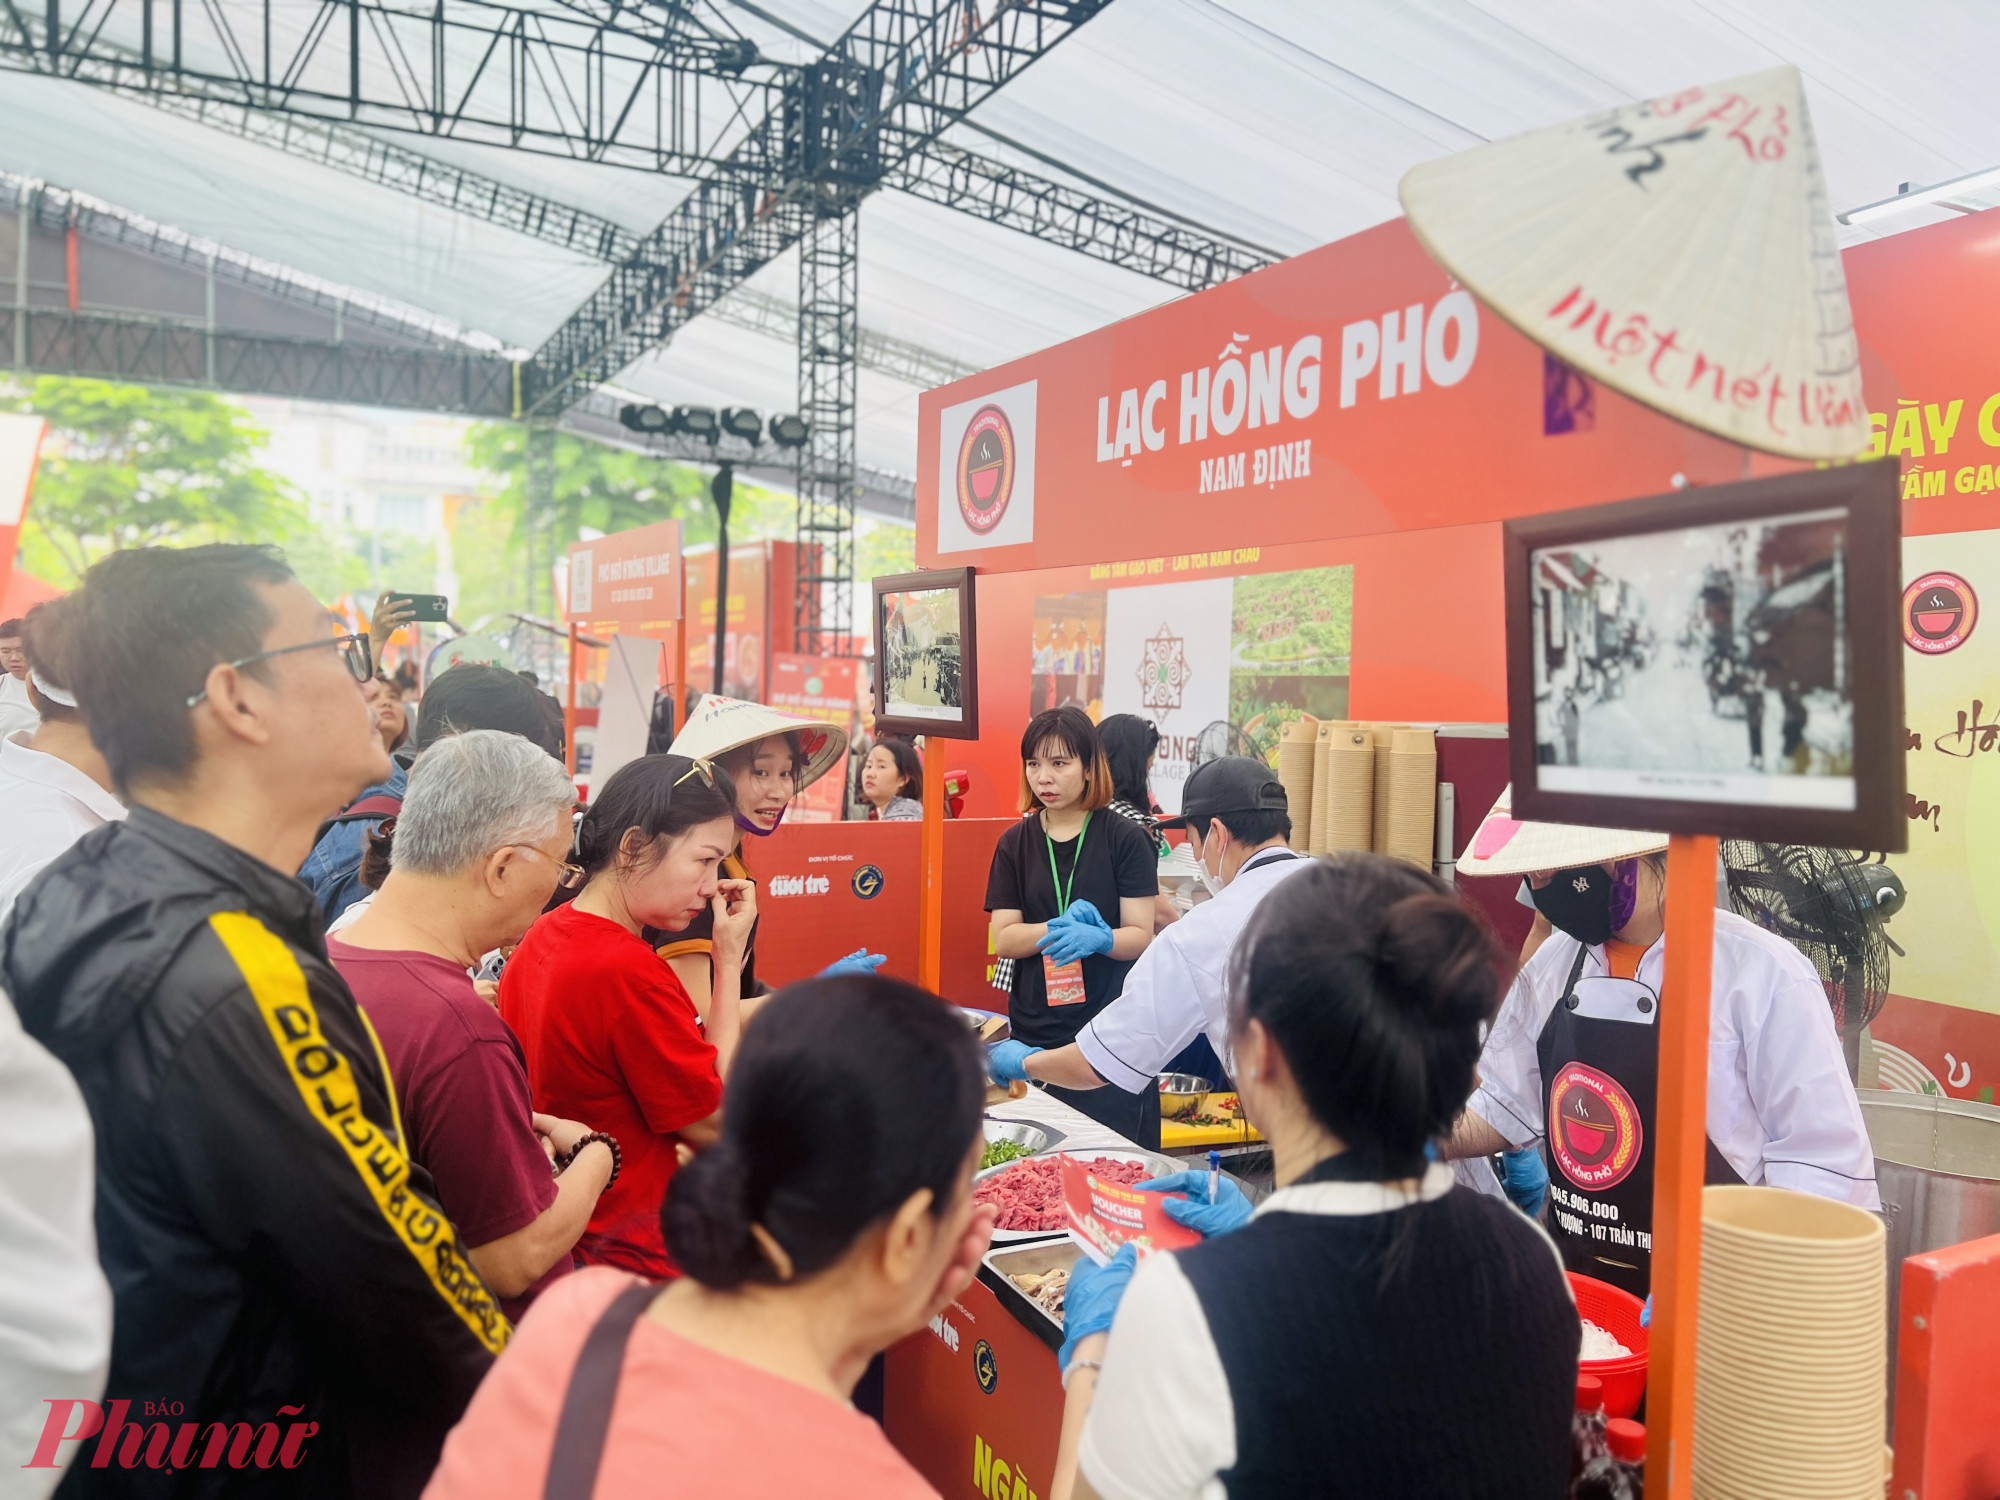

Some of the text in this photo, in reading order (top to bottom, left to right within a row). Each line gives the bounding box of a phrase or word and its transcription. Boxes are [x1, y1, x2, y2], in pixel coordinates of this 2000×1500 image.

[1097, 379, 1166, 467] LẠC
[1179, 331, 1322, 445] HỒNG
[1687, 360, 1788, 437] nét
[1862, 398, 1964, 459] GÀY
[1199, 439, 1312, 494] NAM ĐỊNH
[1901, 464, 2000, 500] ẦM GẠ
[1919, 578, 1957, 588] TRADITIONAL
[1568, 1073, 1605, 1093] TRADITIONAL
[1091, 1192, 1143, 1220] VOUCHER
[1590, 1223, 1606, 1241] 107
[1609, 1222, 1635, 1246] TRẦN
